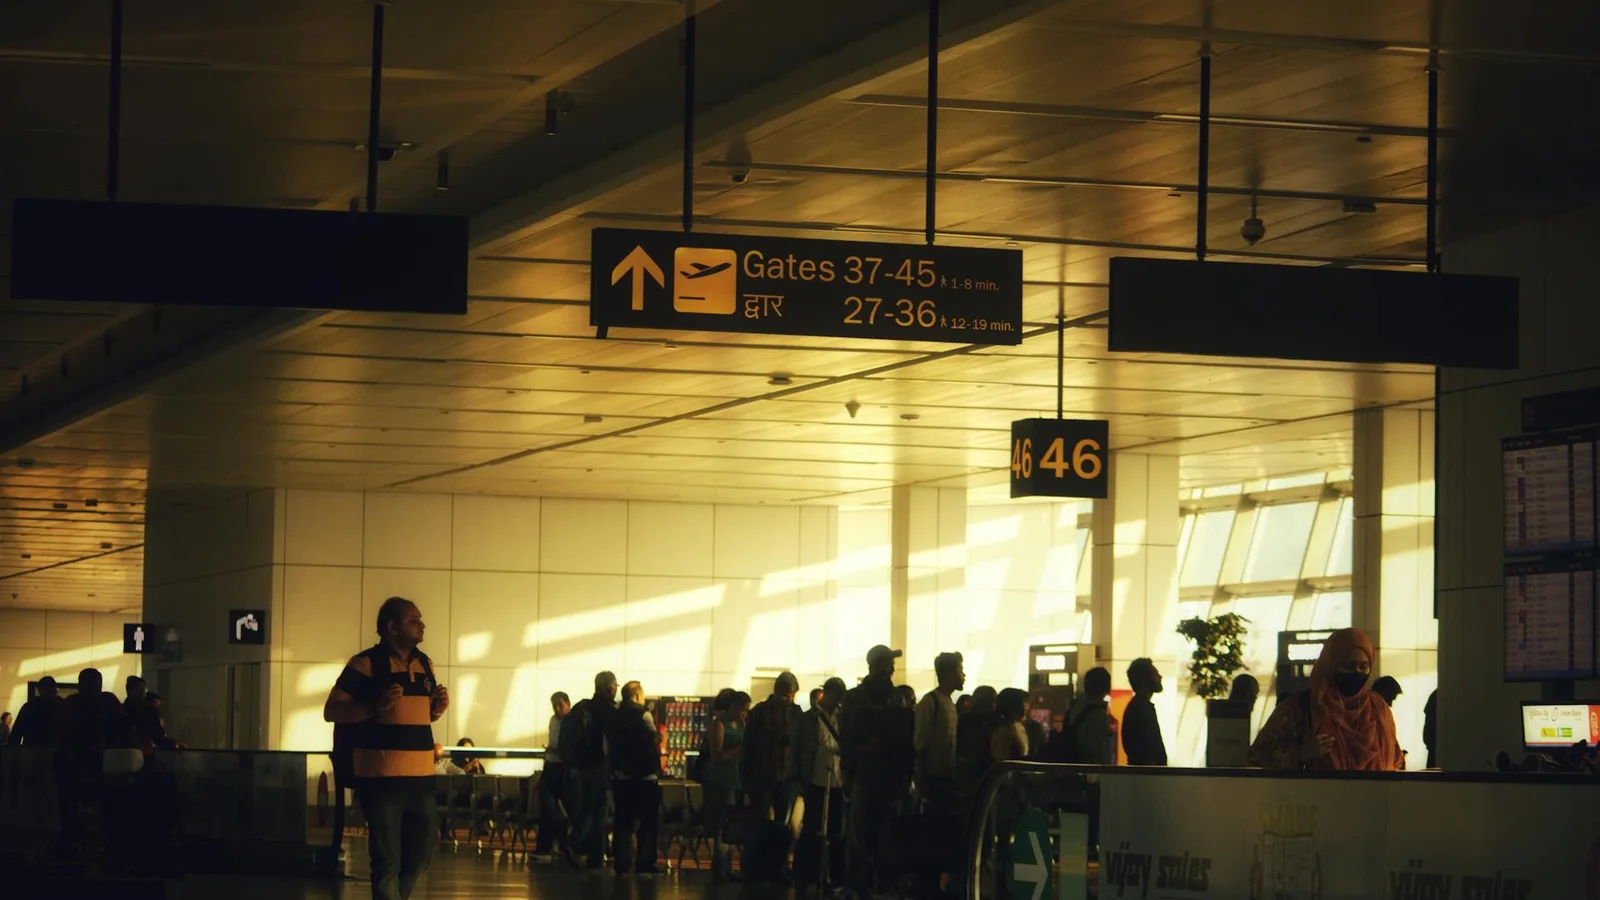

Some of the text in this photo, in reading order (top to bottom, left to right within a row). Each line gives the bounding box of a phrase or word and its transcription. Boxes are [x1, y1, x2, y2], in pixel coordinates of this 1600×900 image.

[743, 250, 1000, 292] Gates 37-45 1-8 min.
[743, 293, 785, 320] द्वार
[843, 296, 1015, 332] 27-36 12-19 min.
[1011, 437, 1033, 480] 46
[1039, 437, 1102, 480] 46
